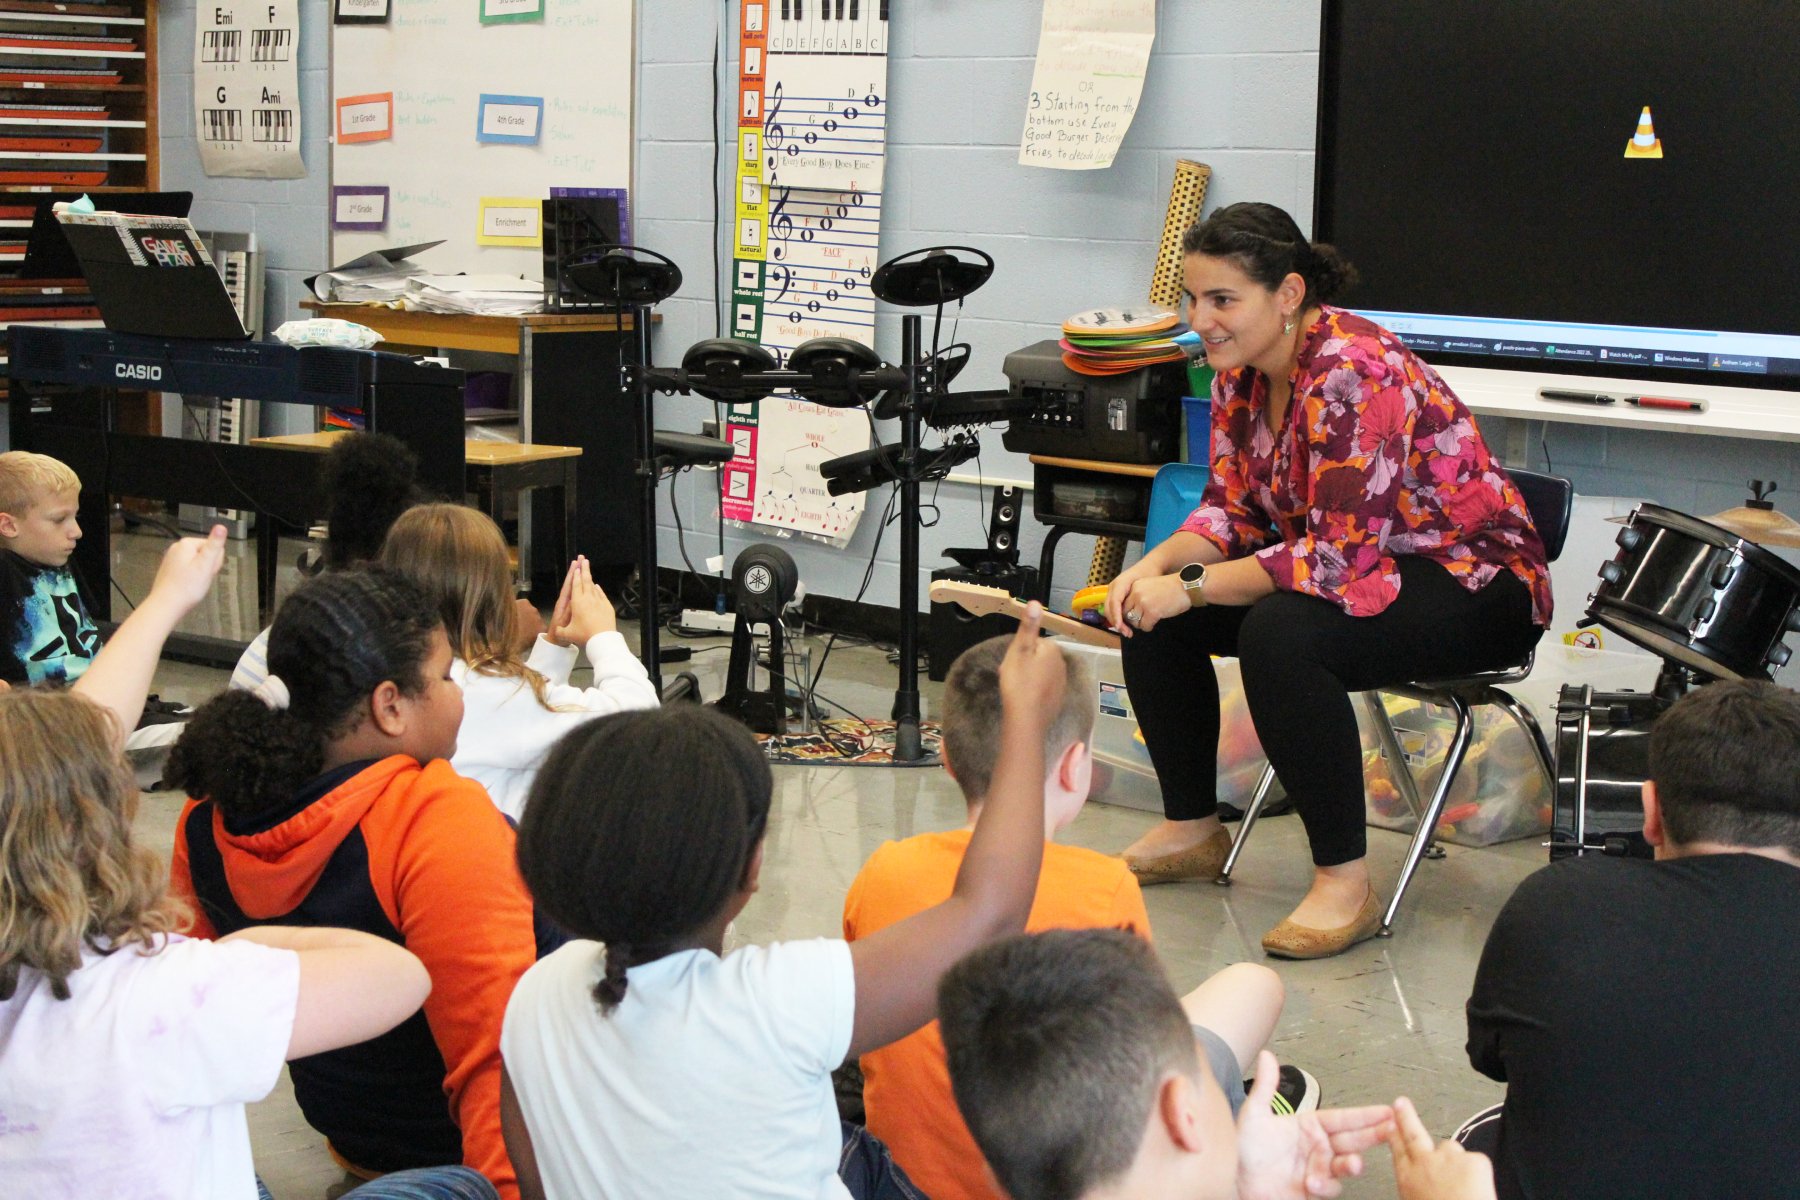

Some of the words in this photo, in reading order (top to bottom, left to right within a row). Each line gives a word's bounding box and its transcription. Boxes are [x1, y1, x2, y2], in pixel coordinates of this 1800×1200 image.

[216, 7, 233, 25] Emi
[268, 6, 276, 23] F
[772, 38, 780, 48] C
[786, 38, 793, 48] D
[800, 38, 806, 48] E
[813, 38, 818, 48] F
[826, 38, 833, 48] G
[840, 39, 847, 49] A
[855, 38, 862, 49] B
[870, 39, 878, 49] C
[848, 88, 855, 98] D
[869, 83, 876, 93] F
[217, 86, 226, 103] G
[261, 86, 281, 104] Ami
[828, 101, 834, 111] B
[1031, 92, 1040, 110] 3
[1045, 91, 1089, 115] Starting
[1094, 96, 1119, 113] from
[359, 113, 376, 122] Grade
[497, 115, 507, 124] 4th
[507, 116, 525, 125] Grade
[808, 115, 816, 124] G
[1029, 113, 1064, 126] bottom
[1067, 119, 1086, 127] use
[791, 127, 797, 136] E
[1025, 127, 1052, 141] Good
[1057, 129, 1089, 145] Burger
[1025, 143, 1052, 158] Fries
[1058, 147, 1067, 158] to
[800, 158, 817, 169] Good
[819, 158, 832, 170] Boy
[835, 158, 852, 170] Does
[850, 180, 857, 191] E
[839, 194, 845, 203] C
[357, 204, 373, 213] Grade
[824, 206, 830, 216] A
[495, 217, 527, 227] Enrichment
[805, 217, 811, 227] F
[141, 236, 187, 254] GAME
[153, 253, 196, 267] PLAN
[848, 258, 853, 268] F
[864, 255, 870, 265] A
[831, 270, 837, 281] D
[812, 281, 819, 291] B
[734, 289, 751, 297] whole
[793, 293, 800, 303] G
[115, 363, 162, 381] CASIO
[728, 415, 745, 423] eighth
[805, 432, 824, 442] WHOLE
[799, 487, 826, 497] QUARTER
[801, 511, 822, 521] EIGHTH
